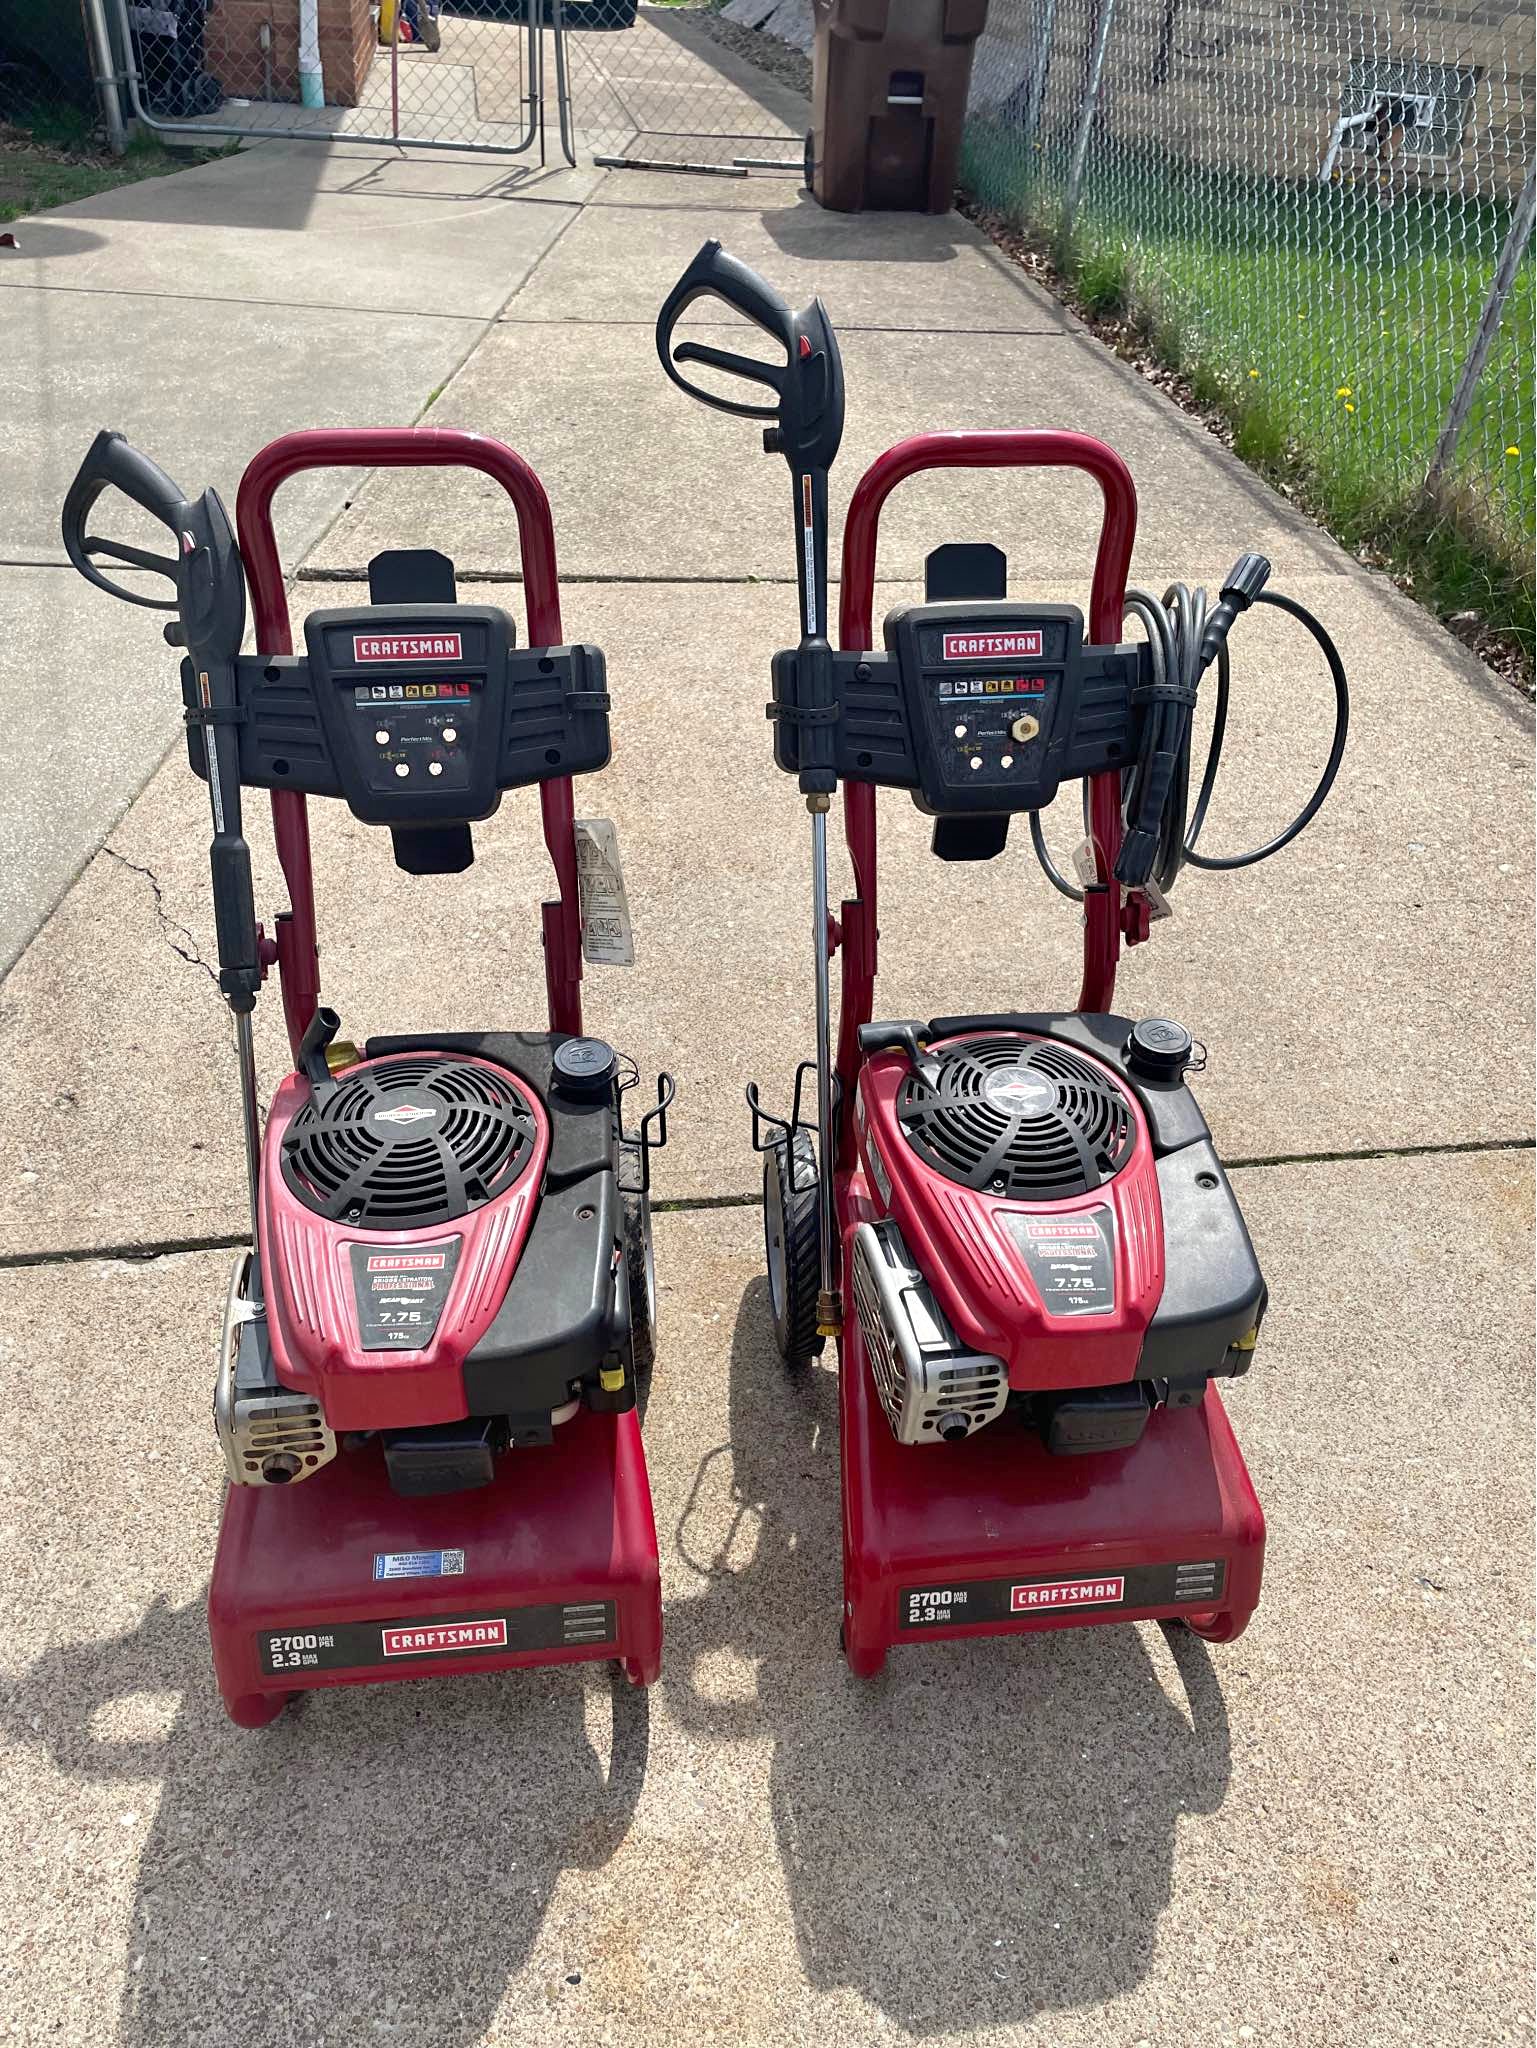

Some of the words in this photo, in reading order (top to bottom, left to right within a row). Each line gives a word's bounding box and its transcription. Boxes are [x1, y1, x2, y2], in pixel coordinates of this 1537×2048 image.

[361, 639, 455, 655] CRAFTSMAN
[950, 637, 1036, 653] CRAFTSMAN
[1031, 1226, 1094, 1236] CRAFTSMAN
[373, 1257, 440, 1268] CRAFTSMAN
[1054, 1278, 1095, 1288] 7.75
[380, 1312, 421, 1323] 7.75
[909, 1590, 952, 1607] 2700
[1018, 1584, 1117, 1604] CRAFTSMAN
[909, 1608, 936, 1623] 2.3
[270, 1635, 317, 1652] 2700
[391, 1627, 499, 1649] CRAFTSMAN
[272, 1652, 301, 1668] 2.3
